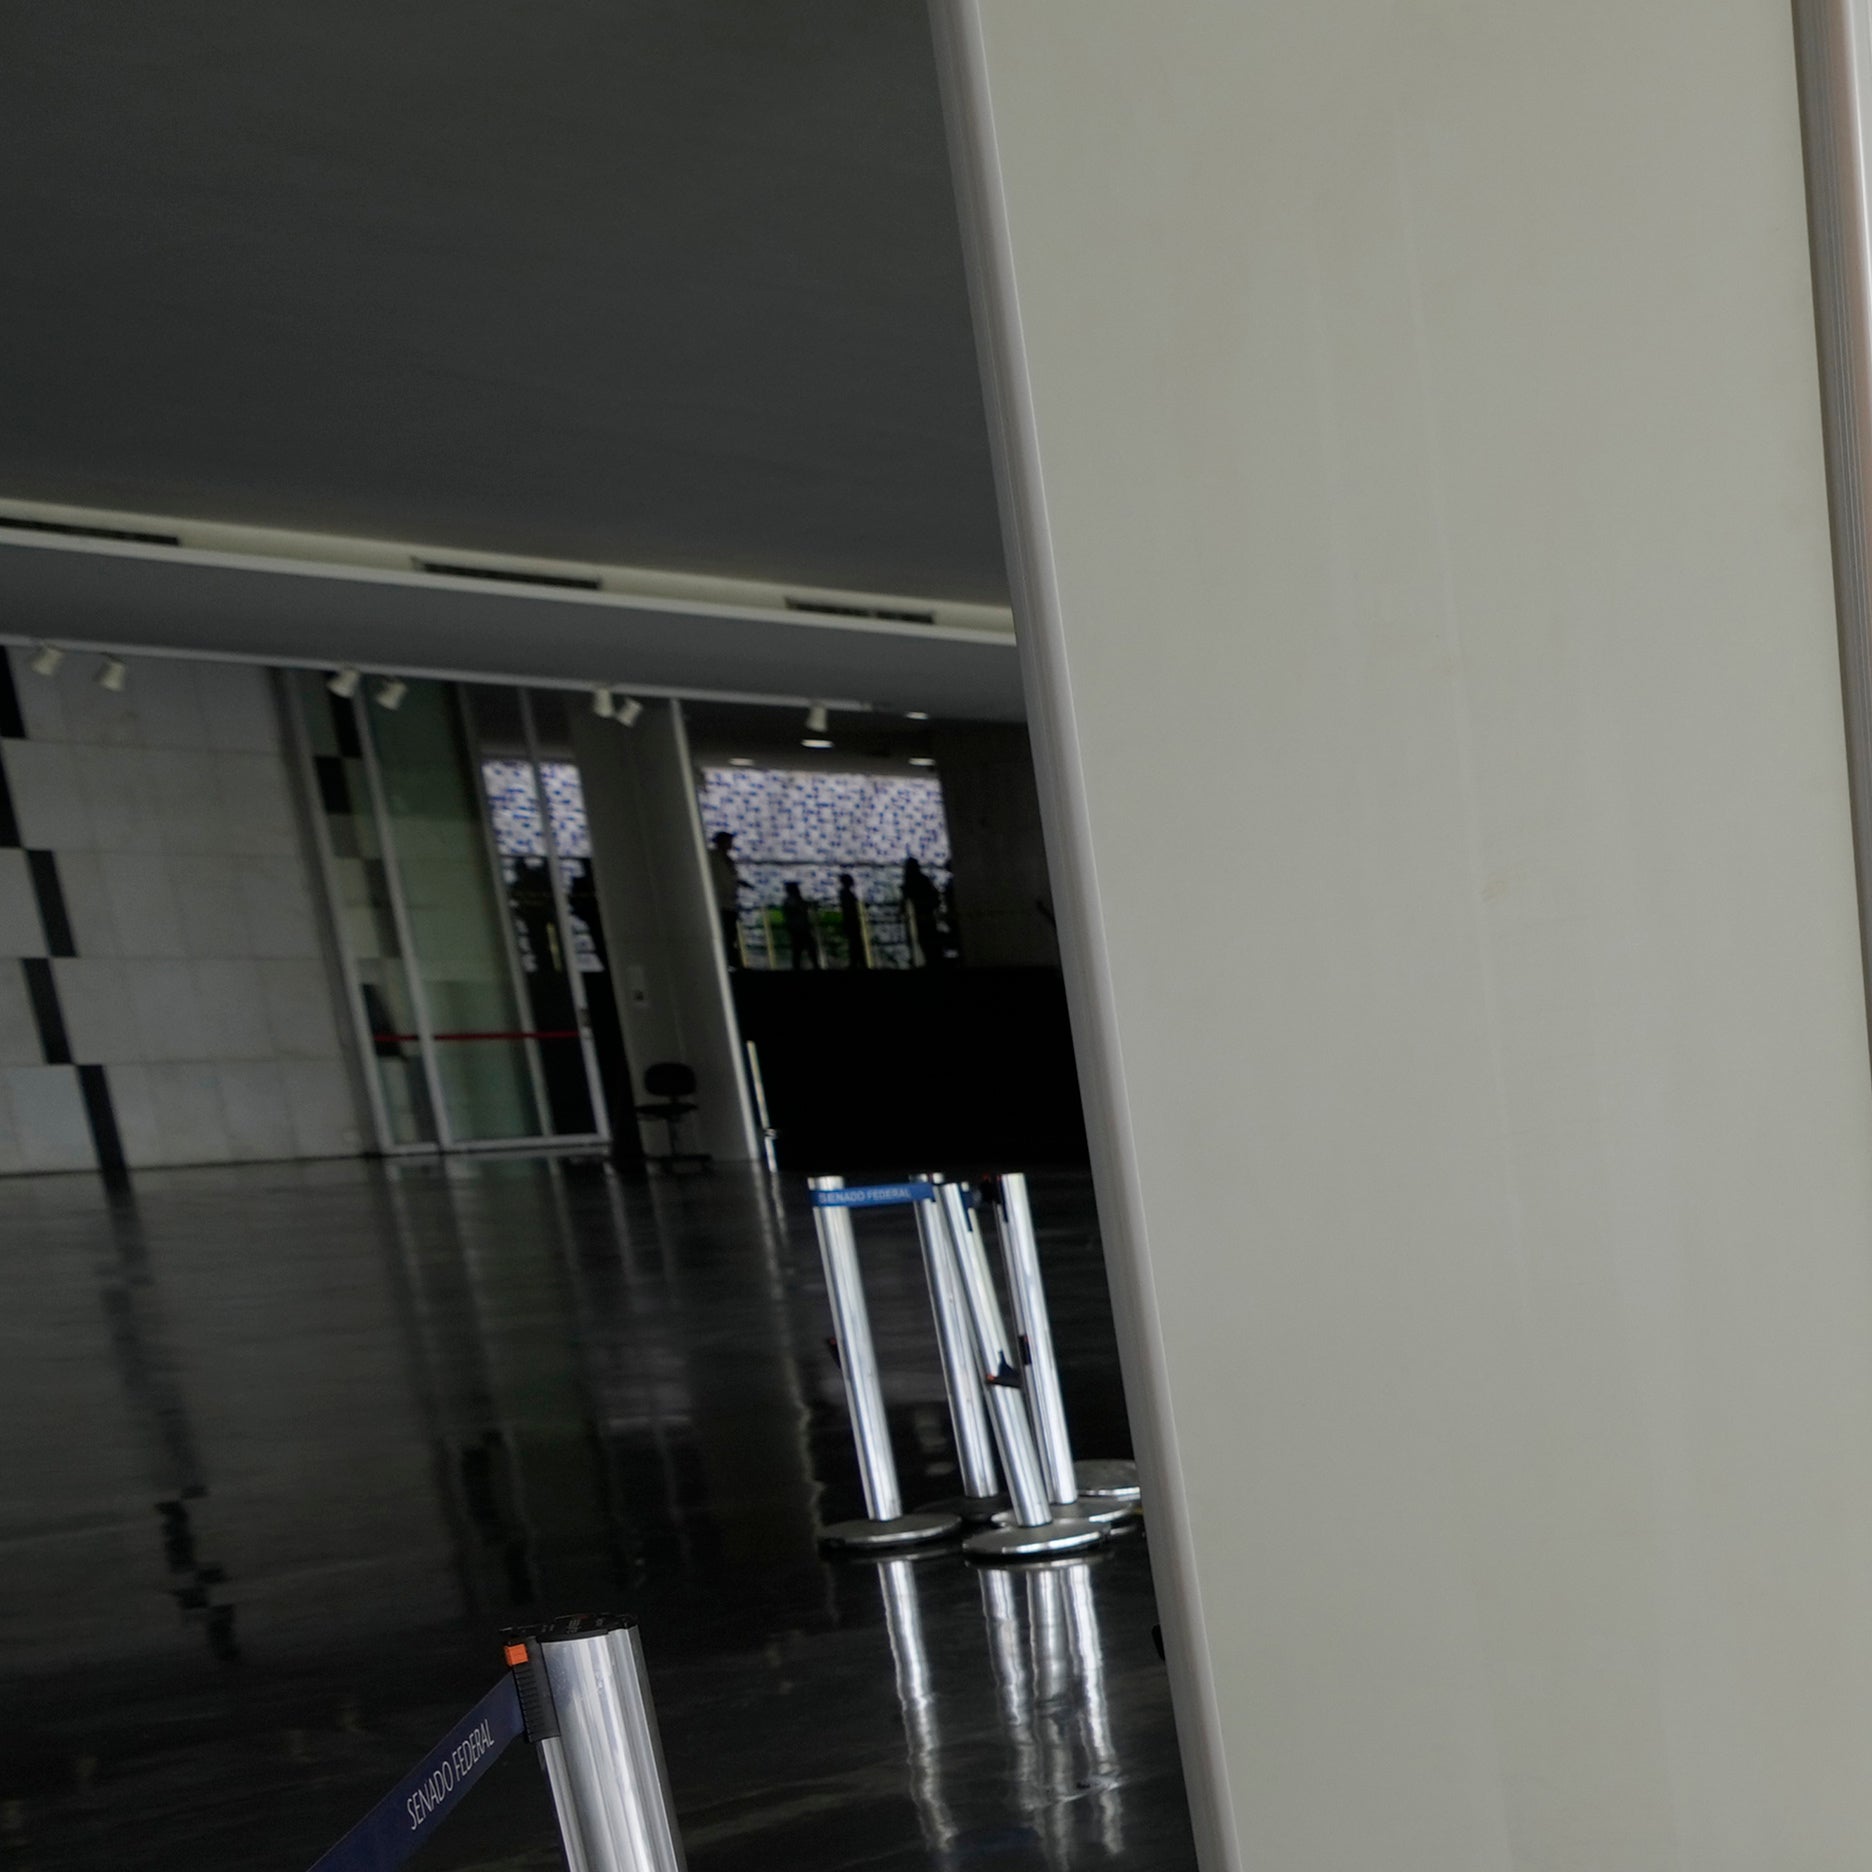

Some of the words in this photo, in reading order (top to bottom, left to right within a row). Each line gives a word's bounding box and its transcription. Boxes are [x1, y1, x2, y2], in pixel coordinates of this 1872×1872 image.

[818, 1190, 865, 1203] SENADO
[867, 1188, 911, 1200] FEDERAL
[407, 1758, 455, 1831] SENADO
[453, 1717, 495, 1787] FEDERAL
